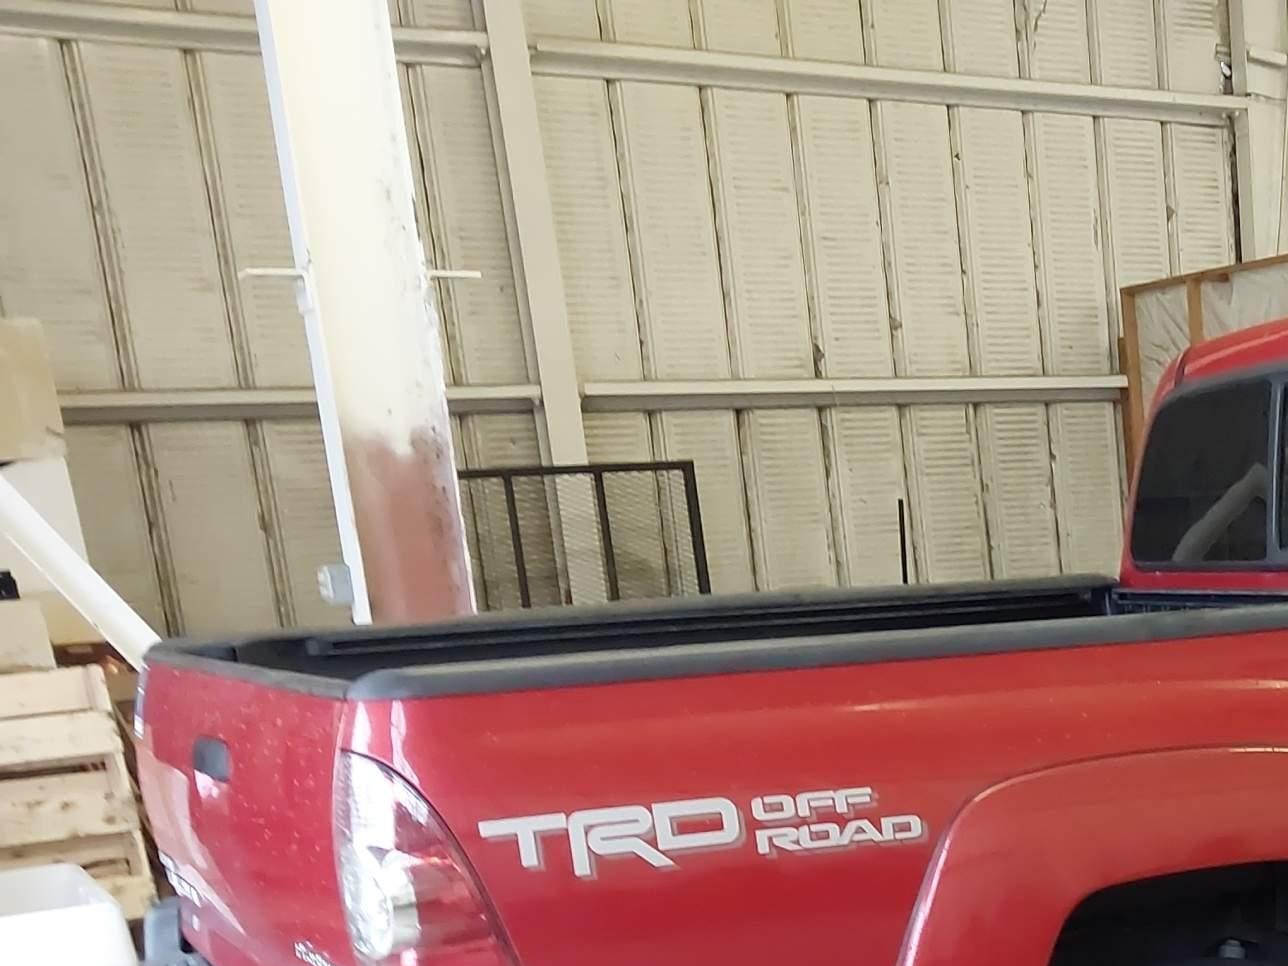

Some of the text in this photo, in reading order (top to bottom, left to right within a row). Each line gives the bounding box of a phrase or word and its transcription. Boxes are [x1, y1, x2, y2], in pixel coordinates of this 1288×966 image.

[751, 787, 873, 822] OFF
[478, 797, 741, 878] TRD
[755, 814, 924, 855] ROAD
